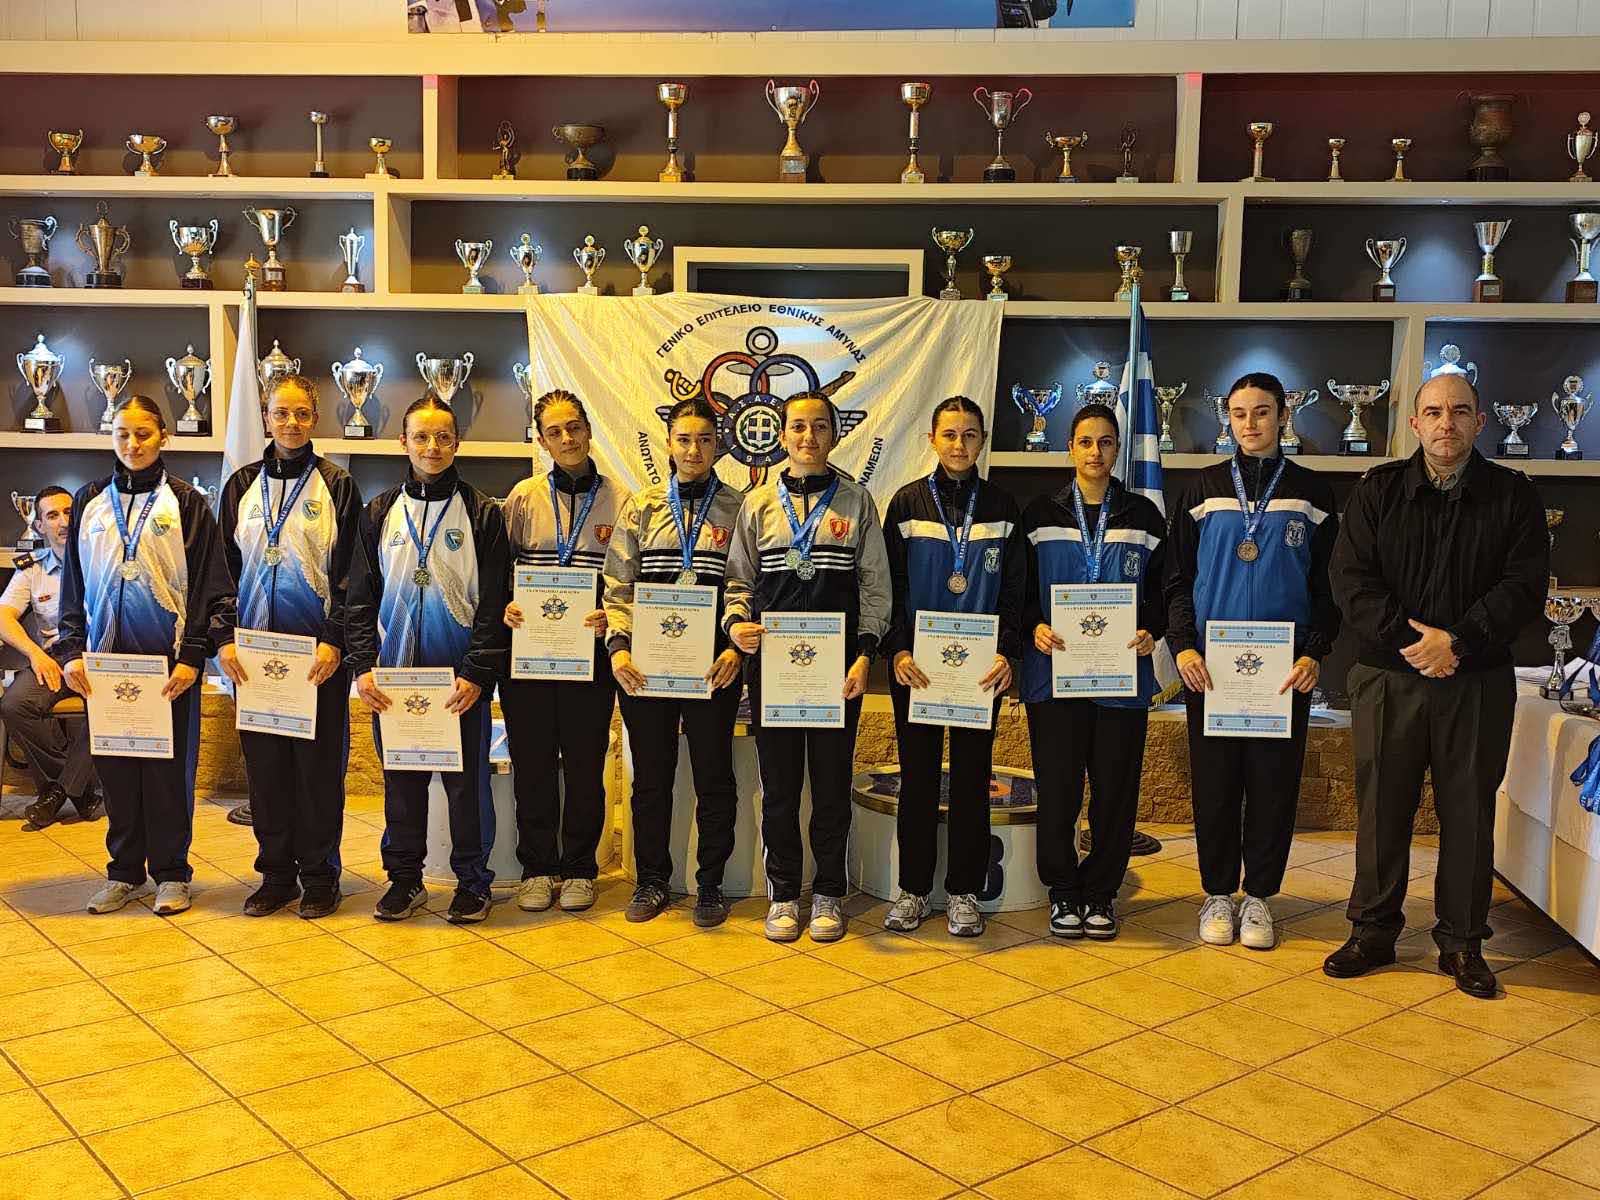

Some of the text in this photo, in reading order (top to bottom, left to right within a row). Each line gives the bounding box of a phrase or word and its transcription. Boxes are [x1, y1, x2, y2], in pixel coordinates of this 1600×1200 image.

[656, 303, 866, 363] ΓΕΝΙΚΟ ΕΠΙΤΕΛΕΙΟ ΕΘΝΙΚΗΣ ΑΜΥΝΑΣ
[637, 431, 883, 487] ΑΝΩΤΑΤΟ ΝΑΜΕΩΝ
